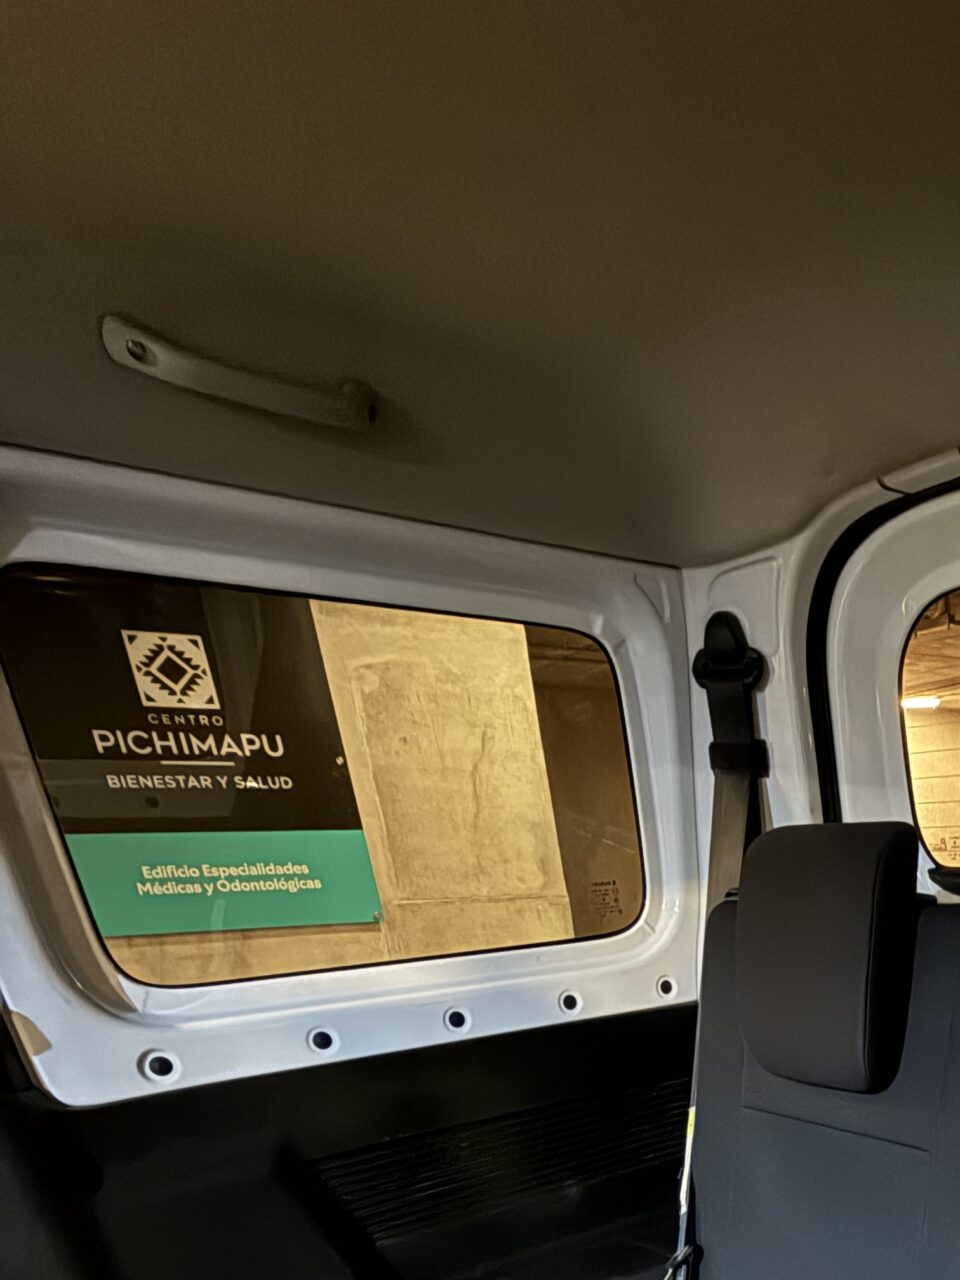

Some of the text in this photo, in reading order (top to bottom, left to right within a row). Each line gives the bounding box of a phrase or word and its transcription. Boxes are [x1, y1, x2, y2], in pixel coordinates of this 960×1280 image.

[147, 713, 224, 727] CENTRO
[91, 729, 285, 758] PICHIMAPU
[106, 774, 293, 790] BIENESTAR Y SALUD
[141, 862, 310, 880] Edificio Especialidades
[136, 878, 322, 896] Médicas y Odontológicas
